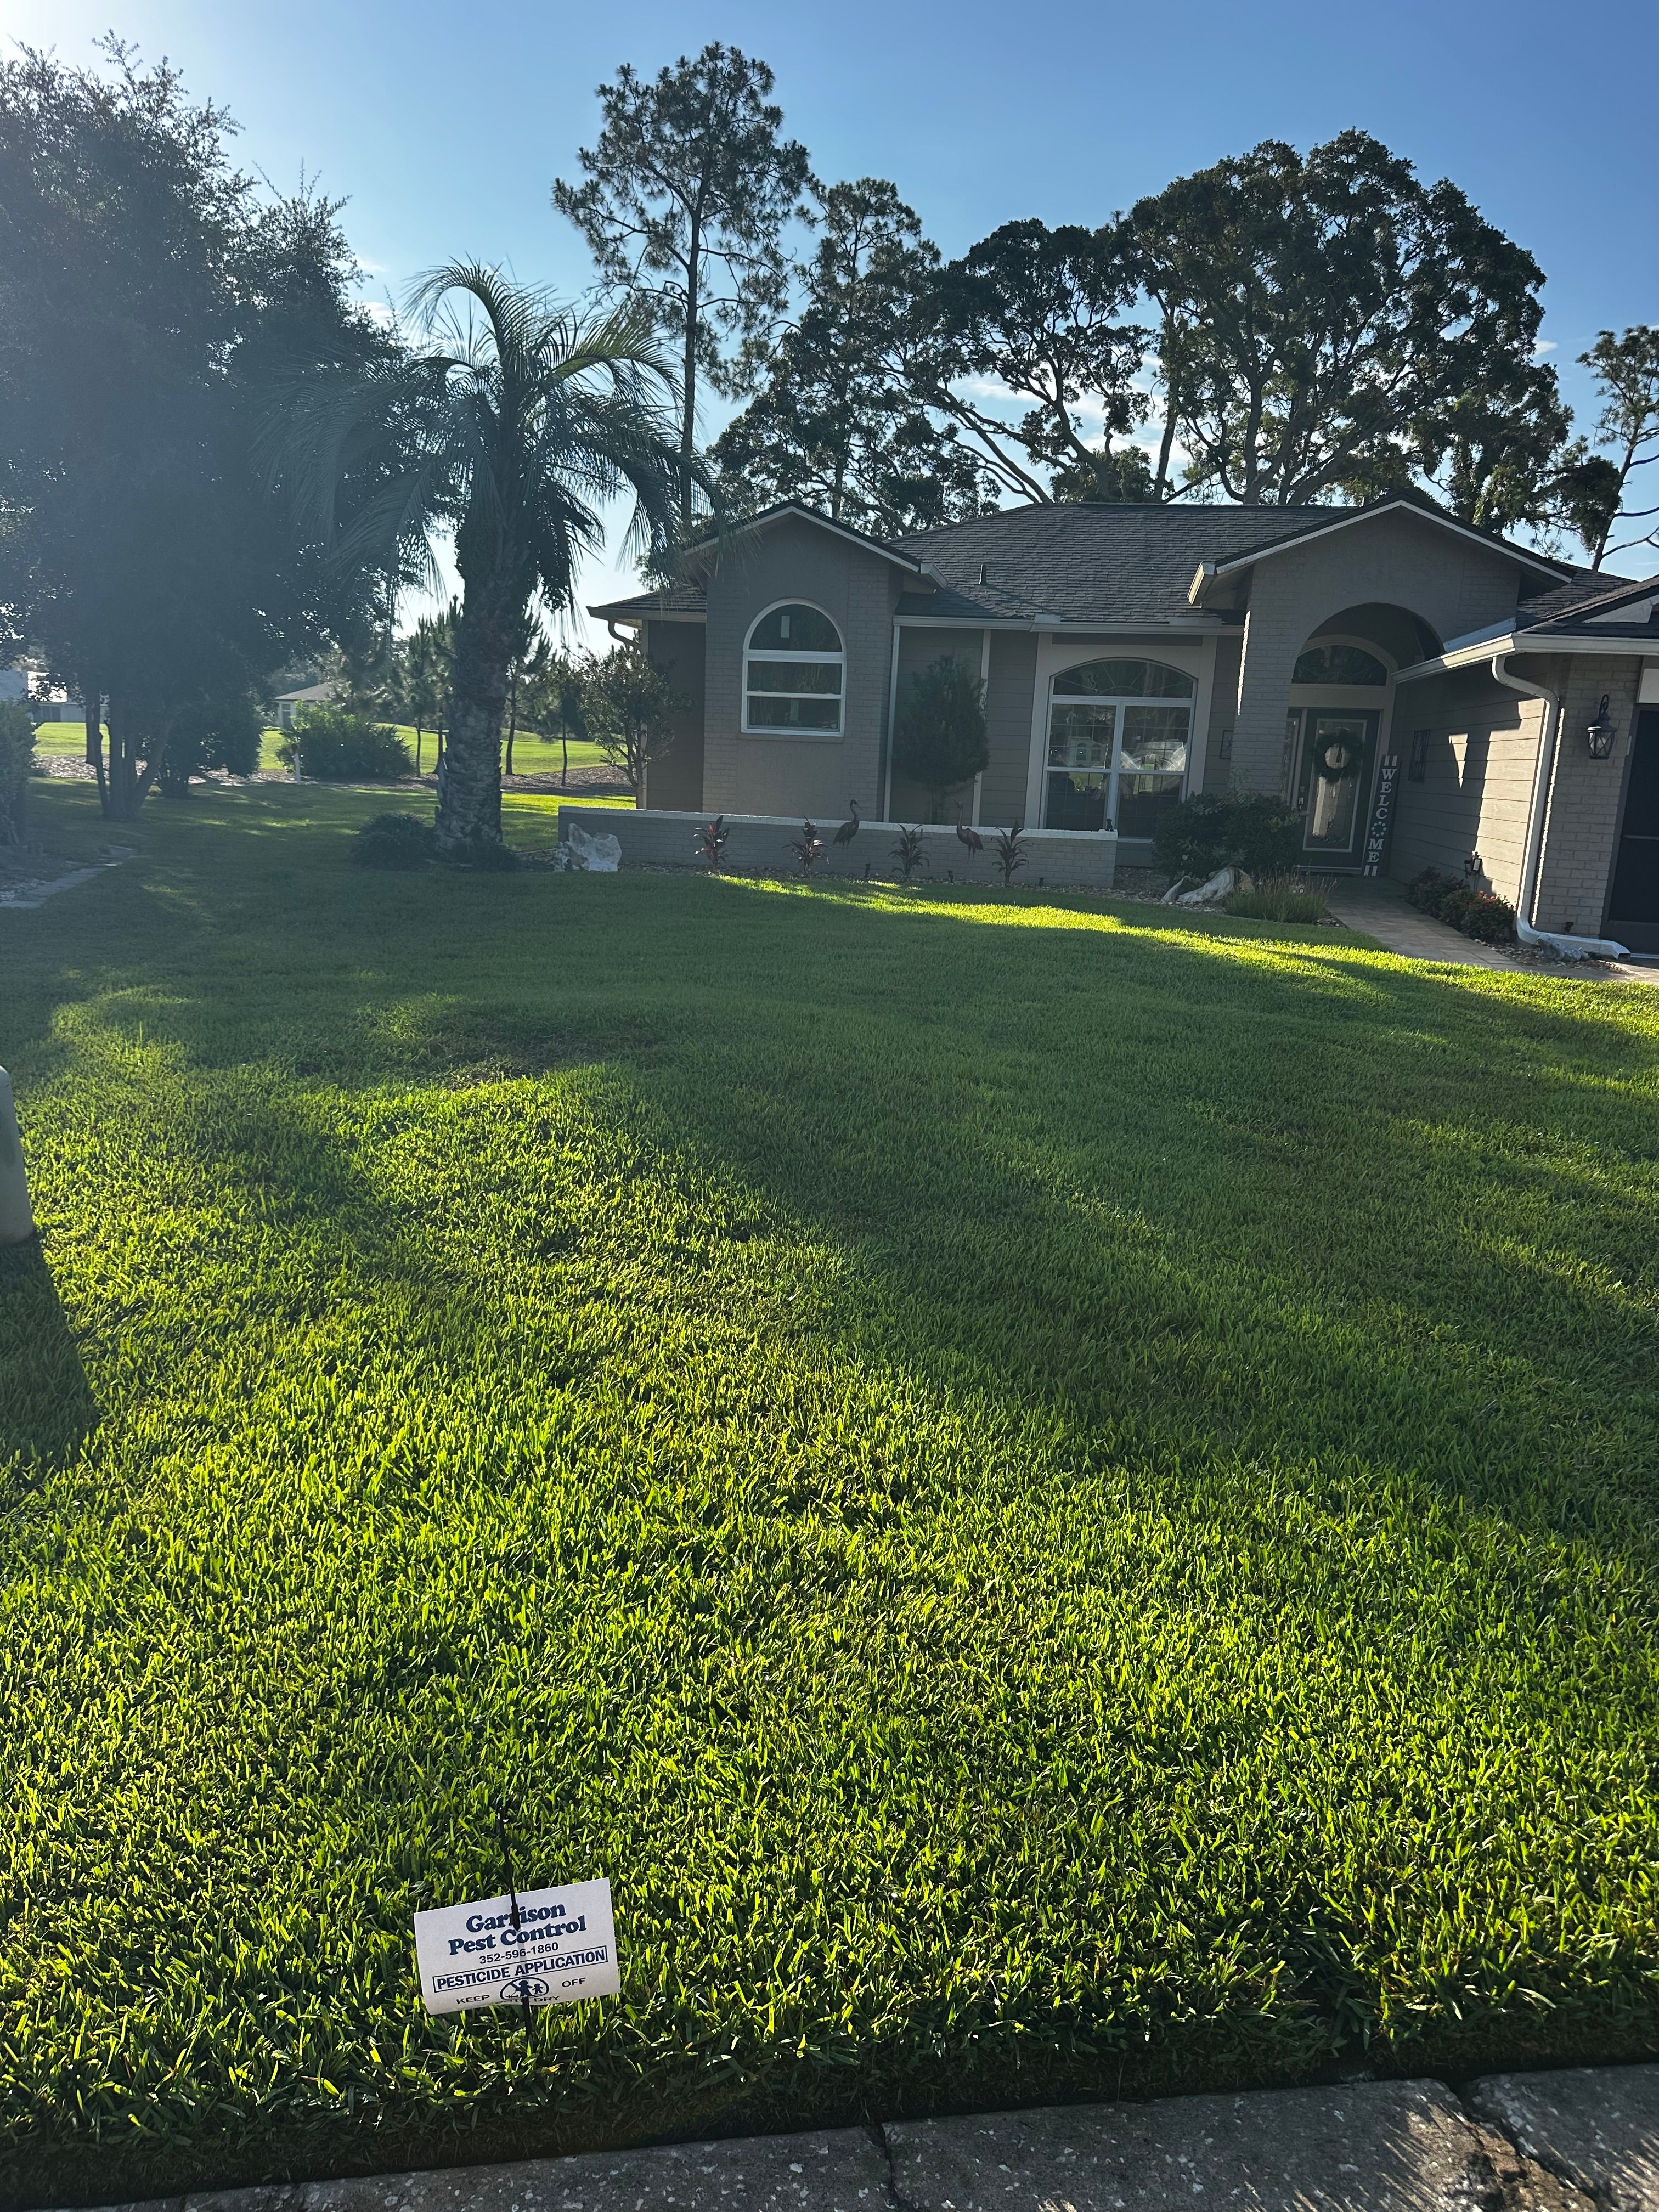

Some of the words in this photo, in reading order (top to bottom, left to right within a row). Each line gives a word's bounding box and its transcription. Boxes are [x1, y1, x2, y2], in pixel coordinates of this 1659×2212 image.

[1367, 769, 1397, 863] WELCOME
[448, 1934, 496, 1955] Pest
[500, 1915, 586, 1946] Control
[479, 1942, 559, 1964] 352-596-1860
[437, 1967, 510, 1989] PESTICIDE
[515, 1949, 605, 1976] APPLICATION
[456, 1994, 490, 2004] KEEP
[562, 1977, 586, 1988] OFF
